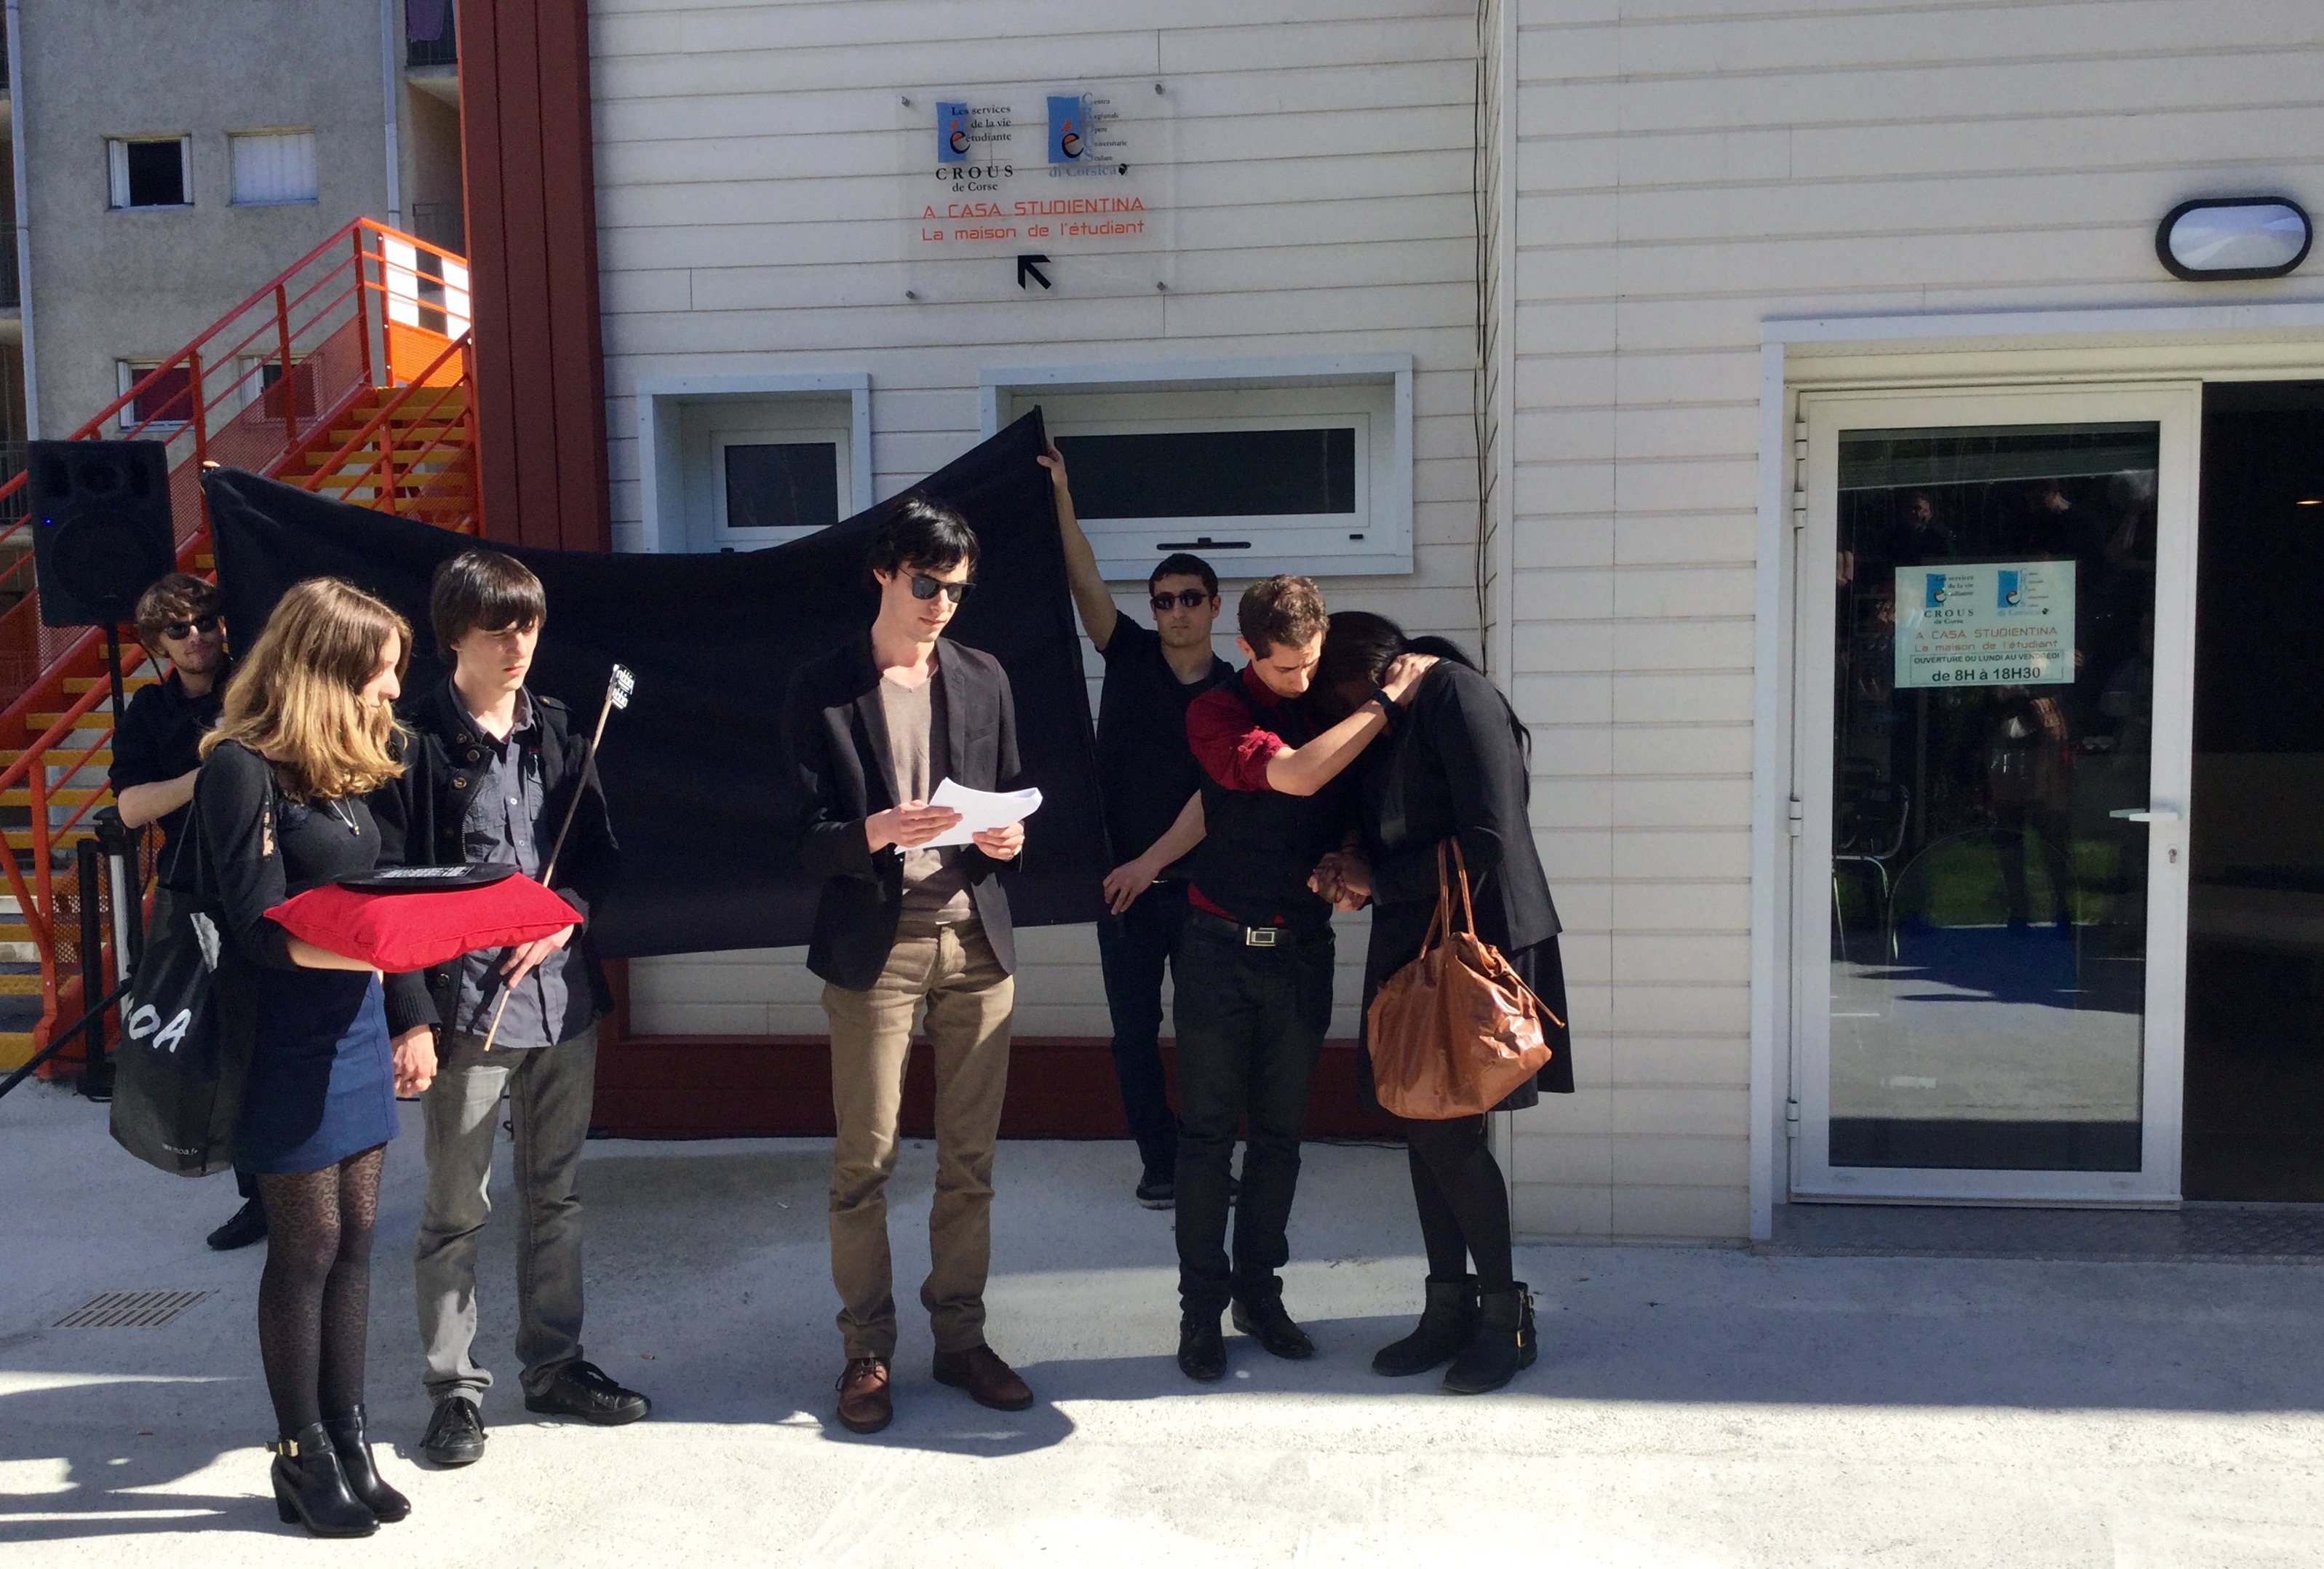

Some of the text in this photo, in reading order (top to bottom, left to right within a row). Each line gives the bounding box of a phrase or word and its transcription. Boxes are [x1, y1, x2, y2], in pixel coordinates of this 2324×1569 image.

[951, 105, 1011, 116] Les services
[971, 118, 1011, 128] de la vie
[966, 132, 1012, 143] étudiante
[936, 165, 1014, 180] CROUS
[1066, 166, 1117, 177] Corsica
[952, 181, 998, 192] de Corse
[923, 197, 1145, 219] A CASA STUDIENTINA
[922, 220, 1145, 241] La maison de l'étudiant
[1924, 609, 1974, 618] CROUS
[1932, 629, 1966, 639] CASA
[1974, 627, 2057, 638] STUDIENTINA
[1914, 644, 1928, 652] La
[1935, 643, 1975, 651] maison
[1982, 642, 1997, 650] de
[2018, 653, 2060, 661] VENDREDI
[1932, 667, 2040, 681] de 8H à 18H30
